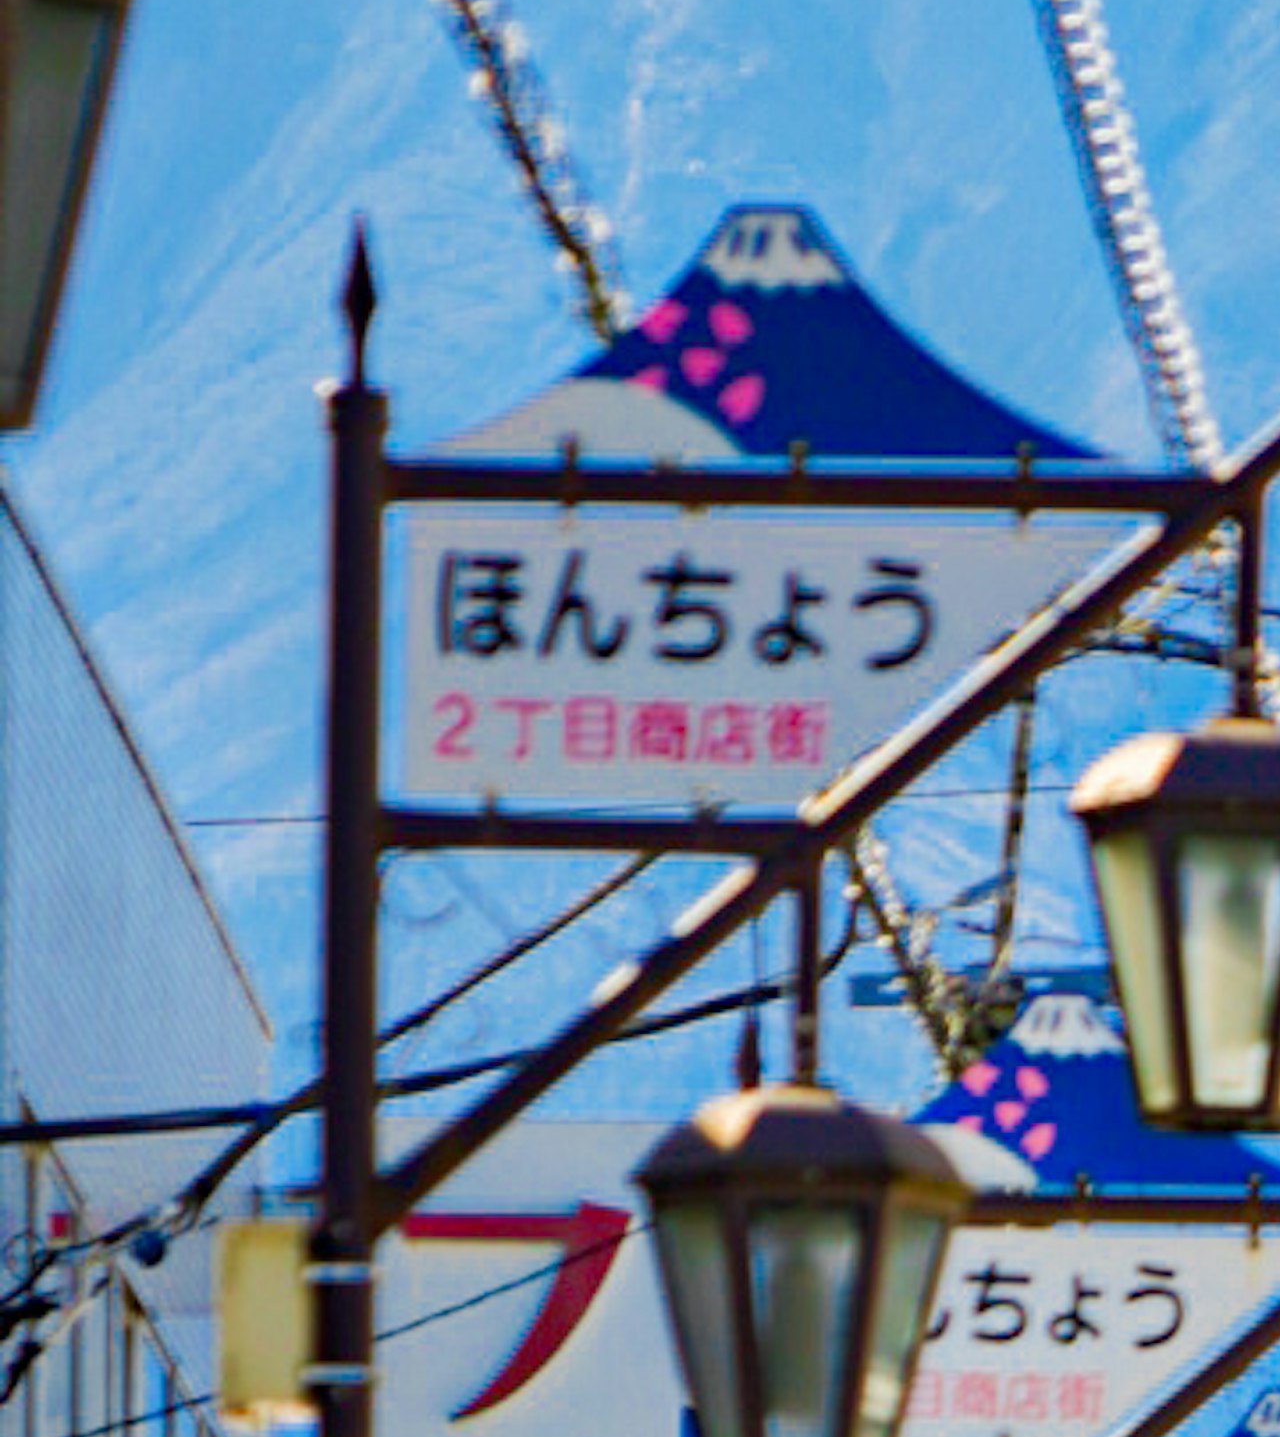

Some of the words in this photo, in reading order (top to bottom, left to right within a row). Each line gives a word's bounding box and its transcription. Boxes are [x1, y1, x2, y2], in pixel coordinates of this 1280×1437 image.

[436, 548, 937, 671] ほんちょう
[432, 690, 828, 764] 2丁目商店街
